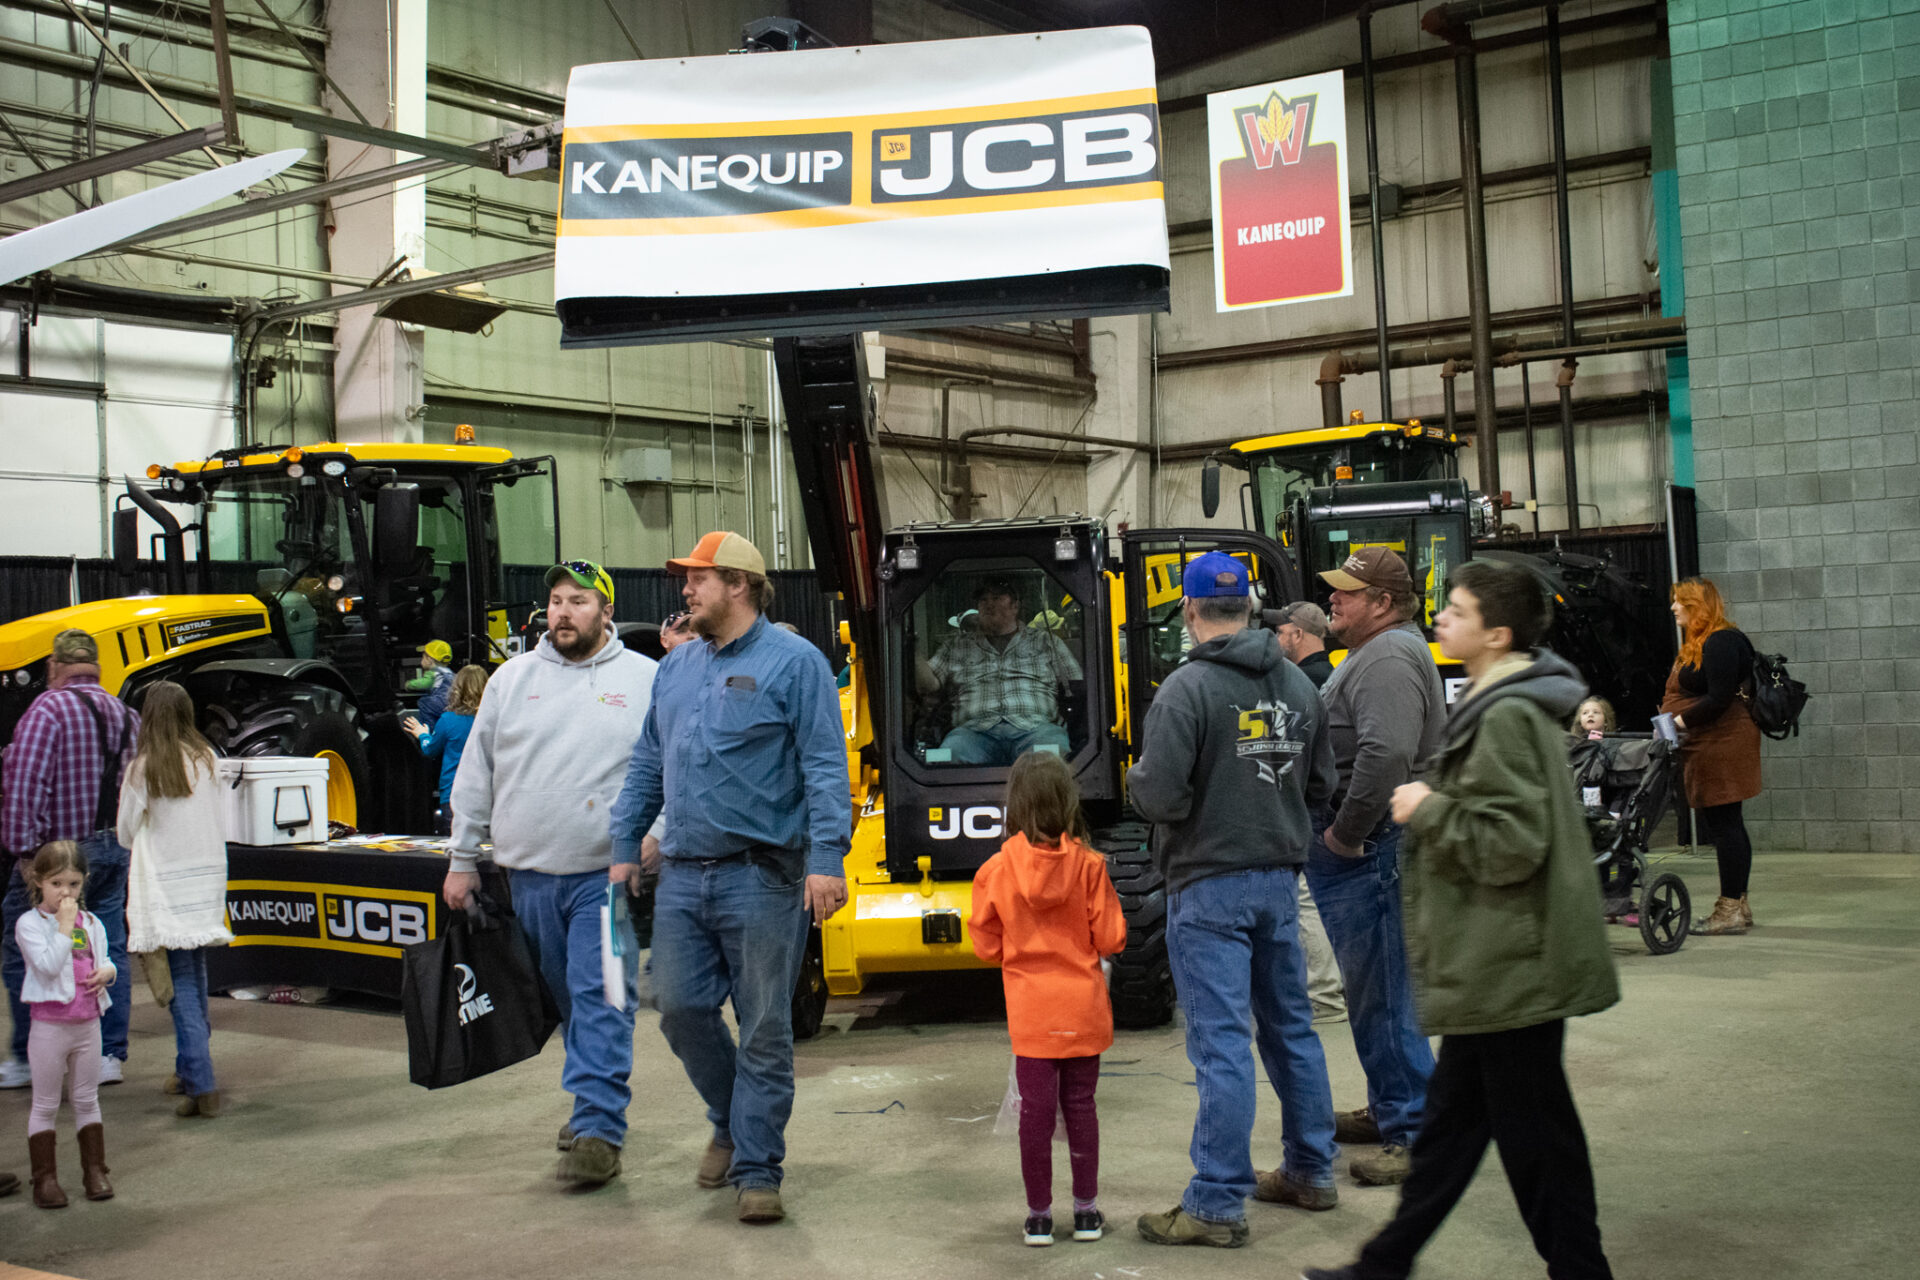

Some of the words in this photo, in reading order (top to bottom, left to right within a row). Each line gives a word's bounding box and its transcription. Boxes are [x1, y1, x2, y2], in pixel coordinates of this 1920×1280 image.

[571, 150, 844, 194] KANEQUIP
[880, 112, 1157, 196] JCB
[1237, 216, 1326, 246] KANEQUIP
[174, 620, 212, 633] FASTRAC
[928, 806, 1007, 839] JC
[228, 901, 316, 925] KANEQUIP
[328, 900, 426, 945] JCB
